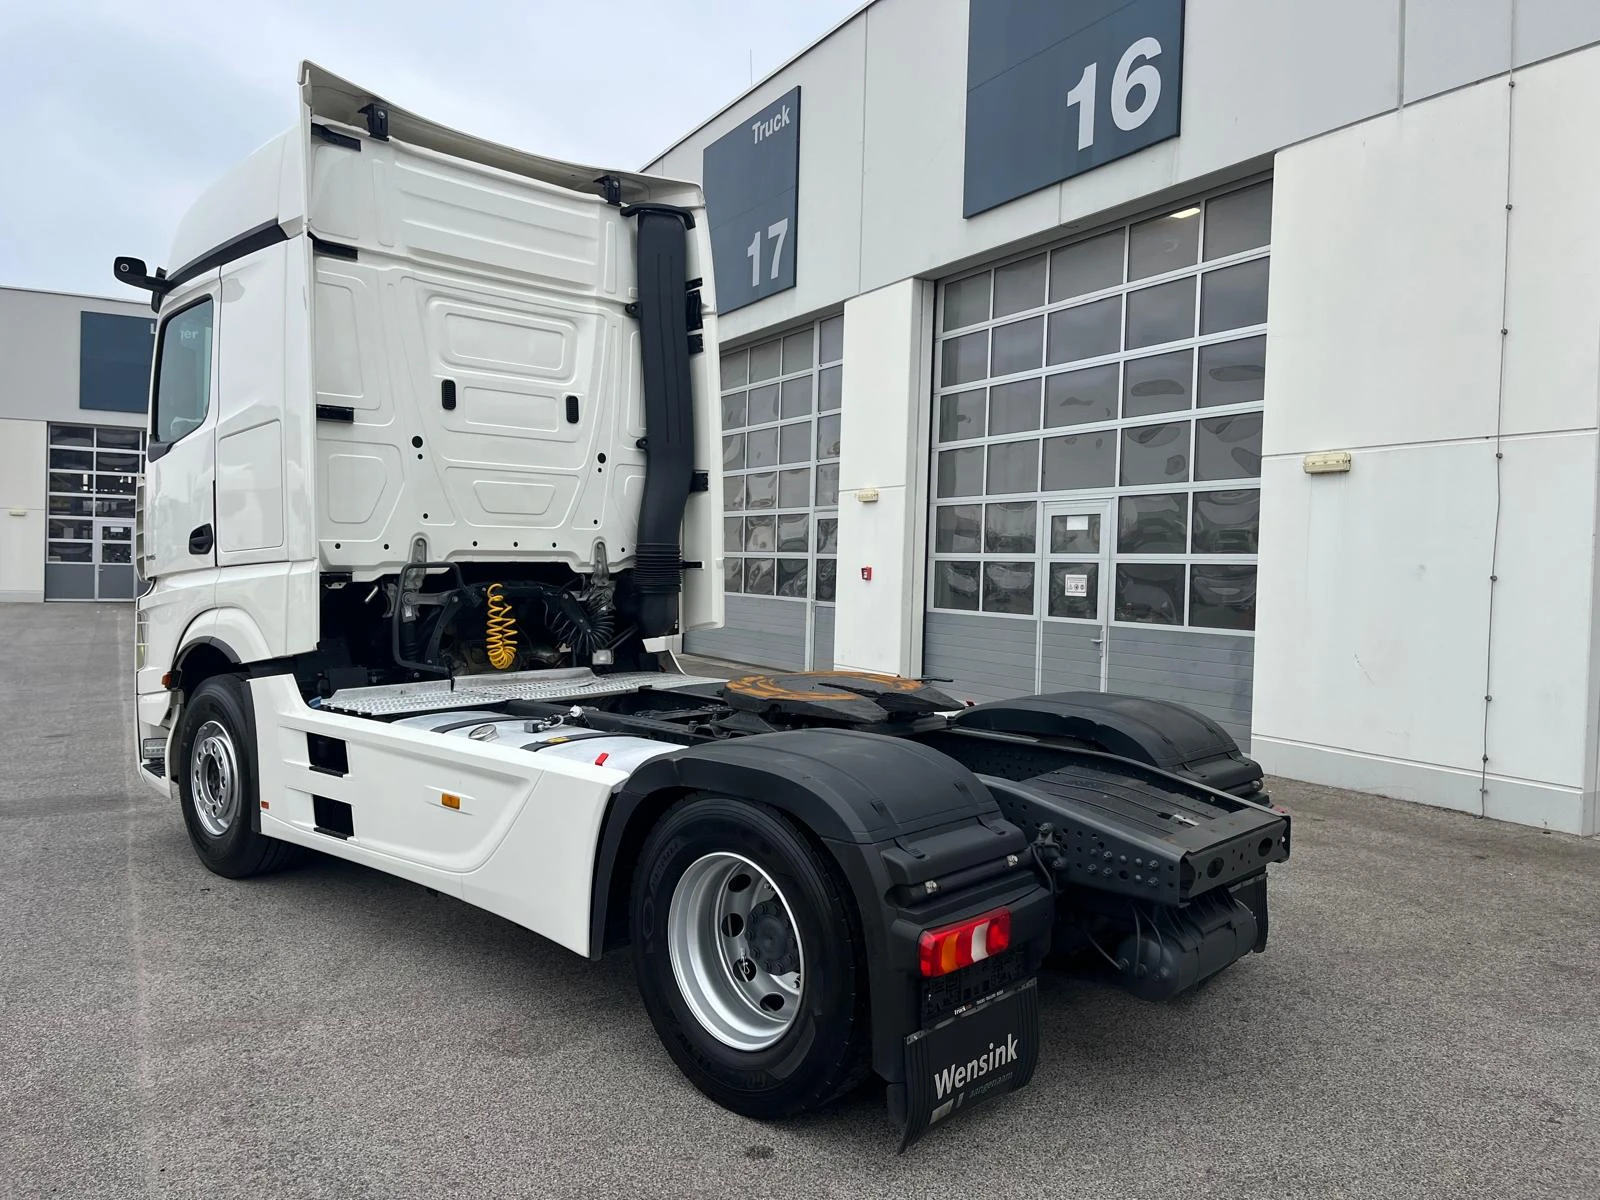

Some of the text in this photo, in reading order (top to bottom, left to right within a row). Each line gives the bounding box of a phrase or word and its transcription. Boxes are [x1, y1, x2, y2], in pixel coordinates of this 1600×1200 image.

[752, 105, 790, 144] Truck
[1066, 37, 1162, 151] 16
[747, 218, 788, 287] 17
[934, 1033, 1018, 1100] Wensink
